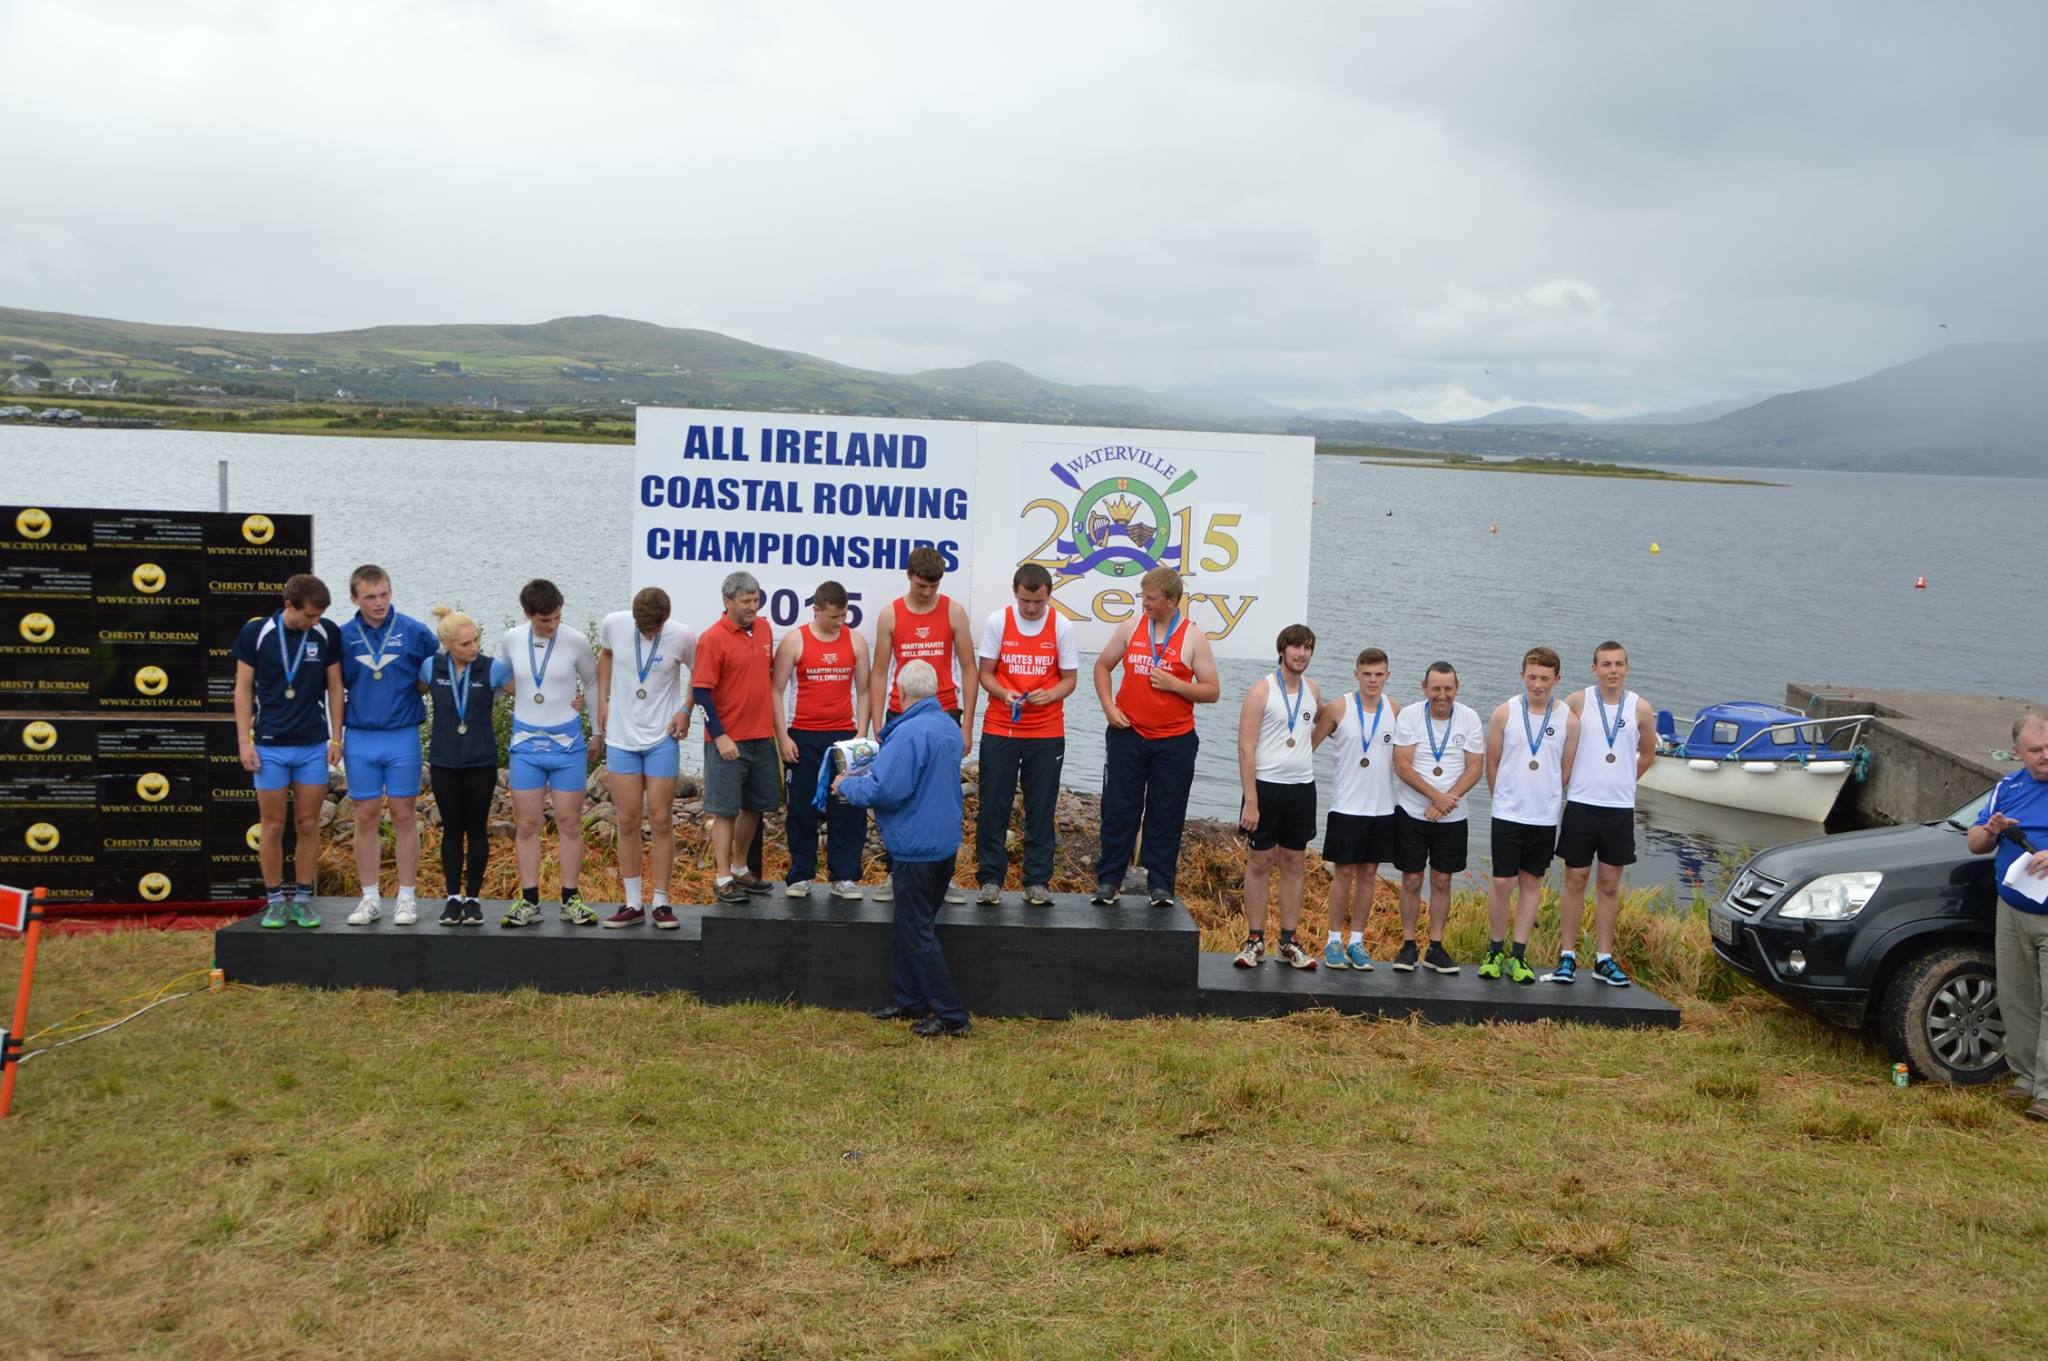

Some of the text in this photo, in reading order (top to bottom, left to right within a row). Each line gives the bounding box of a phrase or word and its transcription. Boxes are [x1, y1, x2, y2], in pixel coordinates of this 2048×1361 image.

[683, 425, 927, 469] ALL IRELAND
[1067, 445, 1177, 480] WATERVILLE
[640, 474, 968, 520] COASTAL ROWING
[207, 547, 307, 557] WWW.CRVLIVE.COM
[209, 580, 255, 591] CHRISTY
[1043, 573, 1258, 641] Kery
[99, 630, 199, 641] CHRISTY RIORDAN
[1001, 653, 1033, 665] HARTES
[1009, 665, 1047, 676] DRILLING
[39, 680, 89, 690] RIORDAN
[102, 804, 203, 814] WWW.CRVLIVE.COM
[104, 837, 201, 848] CHRISTY RIORDAN
